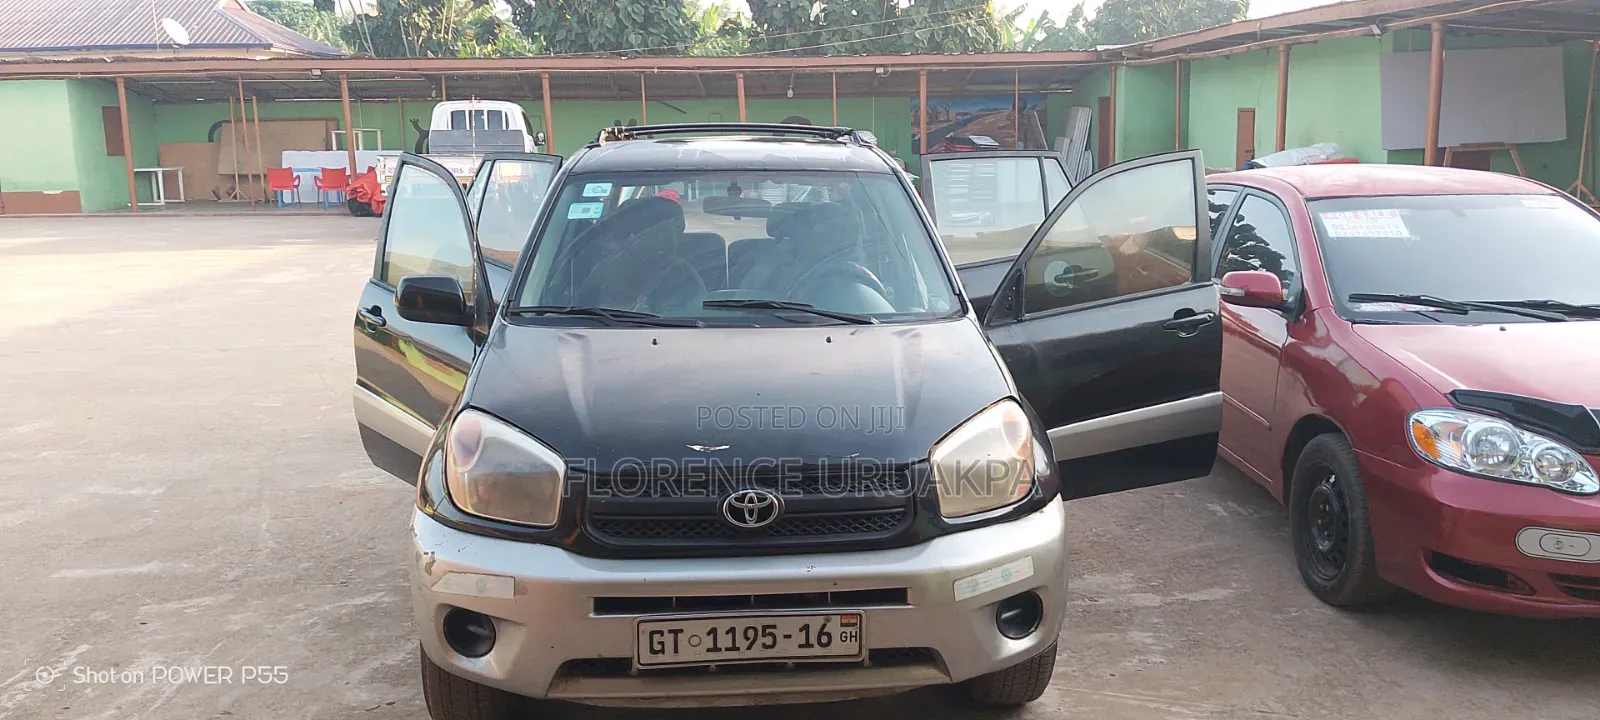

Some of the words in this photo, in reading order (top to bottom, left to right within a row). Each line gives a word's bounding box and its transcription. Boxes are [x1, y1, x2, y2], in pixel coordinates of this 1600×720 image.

[1326, 211, 1353, 219] FOR
[1357, 209, 1394, 220] SALE
[649, 628, 684, 655] GT
[705, 623, 832, 652] 1195-16
[839, 630, 858, 643] GH
